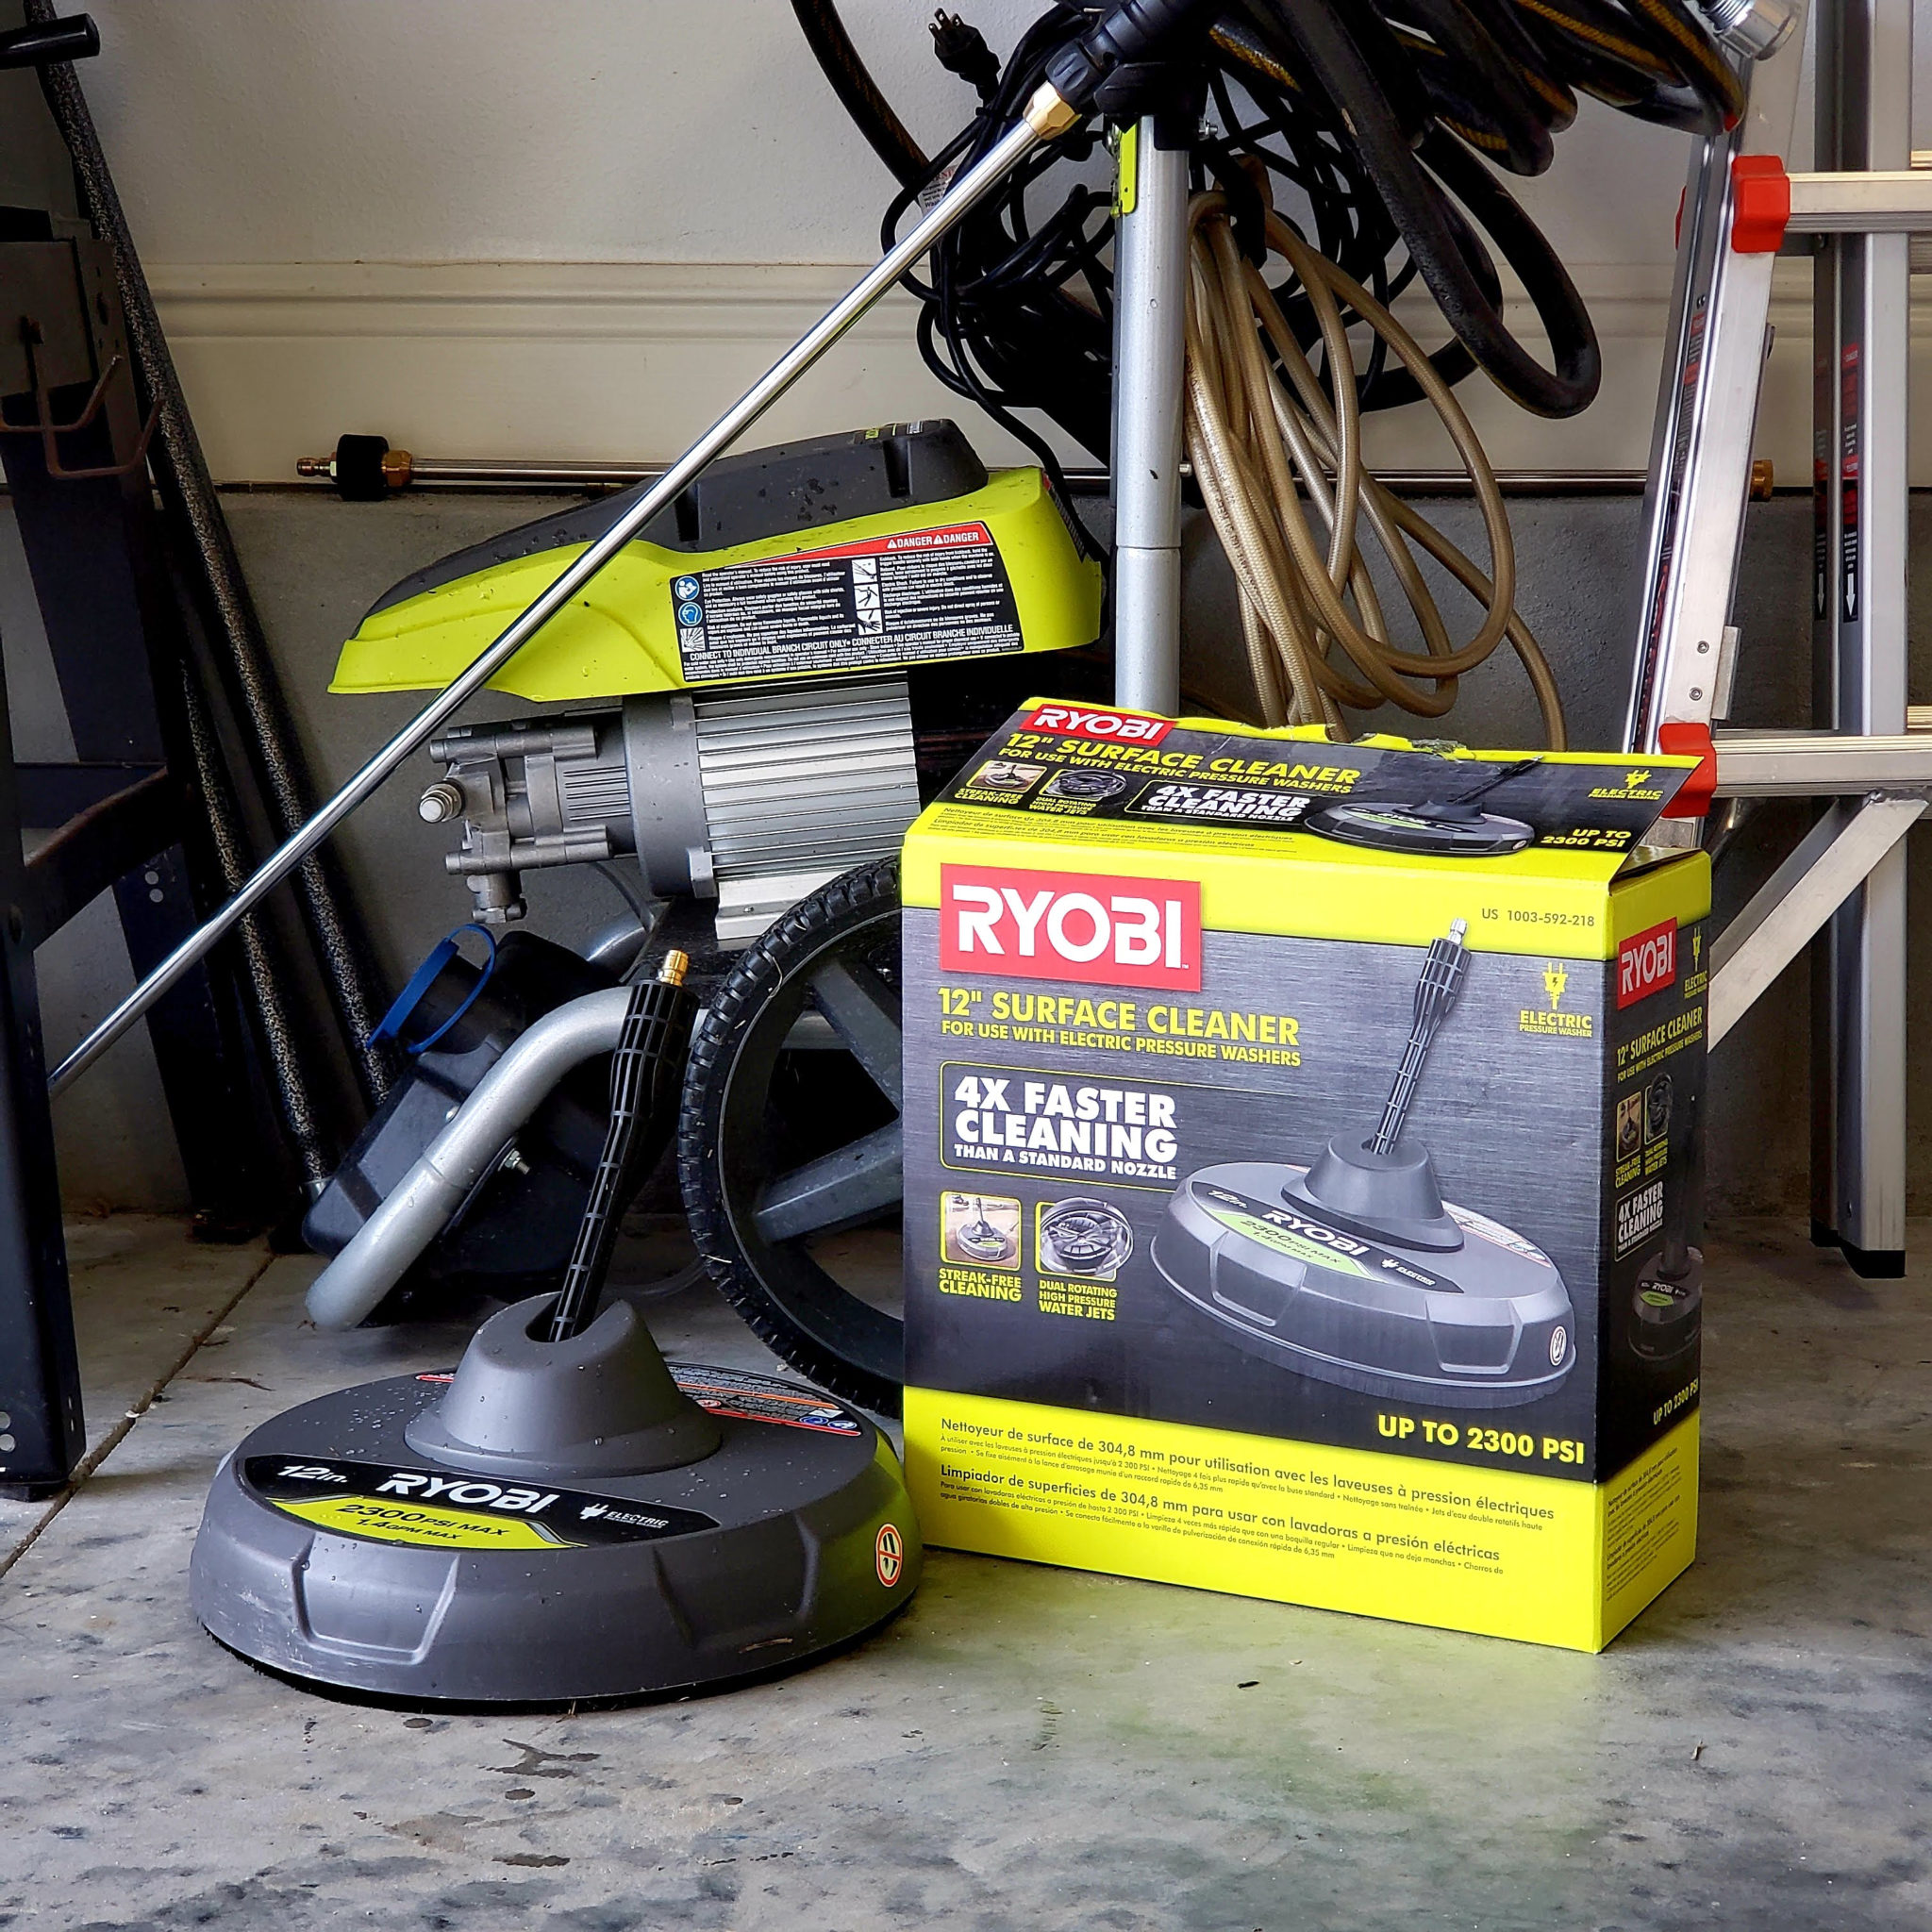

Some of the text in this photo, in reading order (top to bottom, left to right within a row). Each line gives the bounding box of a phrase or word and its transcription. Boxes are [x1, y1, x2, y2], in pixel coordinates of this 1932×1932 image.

[897, 532, 979, 547] DANGER DANGER
[691, 652, 722, 660] CONNECT
[733, 646, 772, 657] INDIVIDUAL
[772, 643, 801, 653] BRANCH
[802, 641, 828, 651] CIRCUIT
[829, 640, 847, 648] ONLY
[852, 635, 892, 646] CONNECTER
[894, 634, 904, 642] AU
[905, 631, 932, 641] CIRCUIT
[933, 628, 965, 639] BRANCHE
[967, 625, 1013, 636] INDIVIDUELLE
[1034, 708, 1165, 741] RYOBI
[999, 748, 1352, 794] FOR USE WITH ELECTRIC PRESSURE WASHERS
[1007, 733, 1361, 785] 12" SURFACE CLEANER
[955, 792, 1019, 805] CLEANING
[1147, 794, 1303, 816] CLEANING
[1156, 786, 1310, 808] 4X FASTER
[1541, 836, 1625, 848] 2300 PSI
[1573, 829, 1632, 839] UP TO
[953, 884, 1182, 969] RYOBI
[1481, 908, 1595, 927] US 1003-592-218
[1622, 931, 1674, 995] RYOBI
[938, 988, 1300, 1046] 12" SURFACE CLEANER
[1519, 1024, 1592, 1038] PRESSURE WASHER
[1520, 1010, 1592, 1028] ELECTRIC
[1631, 1024, 1666, 1059] SURFACE
[1668, 1007, 1702, 1039] CLEANER
[941, 1020, 1301, 1068] FOR USE WITH ELECTRIC PRESSURE WASHERS
[955, 1075, 1177, 1129] 4X FASTER
[955, 1108, 1178, 1164] CLEANING
[954, 1143, 1177, 1181] THAN A STANDARD NOZZLE
[1619, 1181, 1663, 1223] 4X FASTER
[1261, 1210, 1370, 1256] RYOBI
[1618, 1200, 1663, 1243] CLEANING
[939, 1267, 1022, 1290] STREAK-FREE
[939, 1279, 1023, 1303] CLEANING
[1039, 1279, 1118, 1299] DUAL ROTATING
[1039, 1291, 1116, 1309] HIGH PRESSURE
[1039, 1301, 1115, 1322] WATER JETS
[1654, 1407, 1662, 1424] UP
[1378, 1415, 1585, 1465] UP TO 2300 PSI
[277, 1465, 348, 1483] 12in.
[941, 1417, 1554, 1519] Nettoyeur de surface de 304,8 mm pour utilisation avec les laveuses à pression électriques
[946, 1435, 967, 1444] utiliser
[985, 1440, 993, 1448] les
[994, 1441, 1022, 1453] laveuses
[1029, 1449, 1056, 1457] pression
[1057, 1451, 1091, 1464] électriques
[1118, 1459, 1123, 1468] 2
[1124, 1460, 1138, 1470] 300
[1139, 1463, 1149, 1472] PSI
[1157, 1466, 1191, 1479] Nettoyage
[1192, 1471, 1197, 1479] 4
[1199, 1472, 1211, 1481] fois
[1212, 1474, 1226, 1484] plus
[1227, 1478, 1249, 1488] rapide
[1286, 1485, 1303, 1494] buse
[1304, 1489, 1334, 1499] standard
[1342, 1493, 1379, 1507] Nettoyage
[375, 1473, 560, 1513] RYOBI
[608, 1511, 669, 1526] ELECTRIC
[941, 1463, 1499, 1560] Limpiador de superficies de 304,8 mm para usar con lavadoras a presión eléctricas
[425, 1530, 463, 1540] MAX
[458, 1523, 509, 1536] MAX
